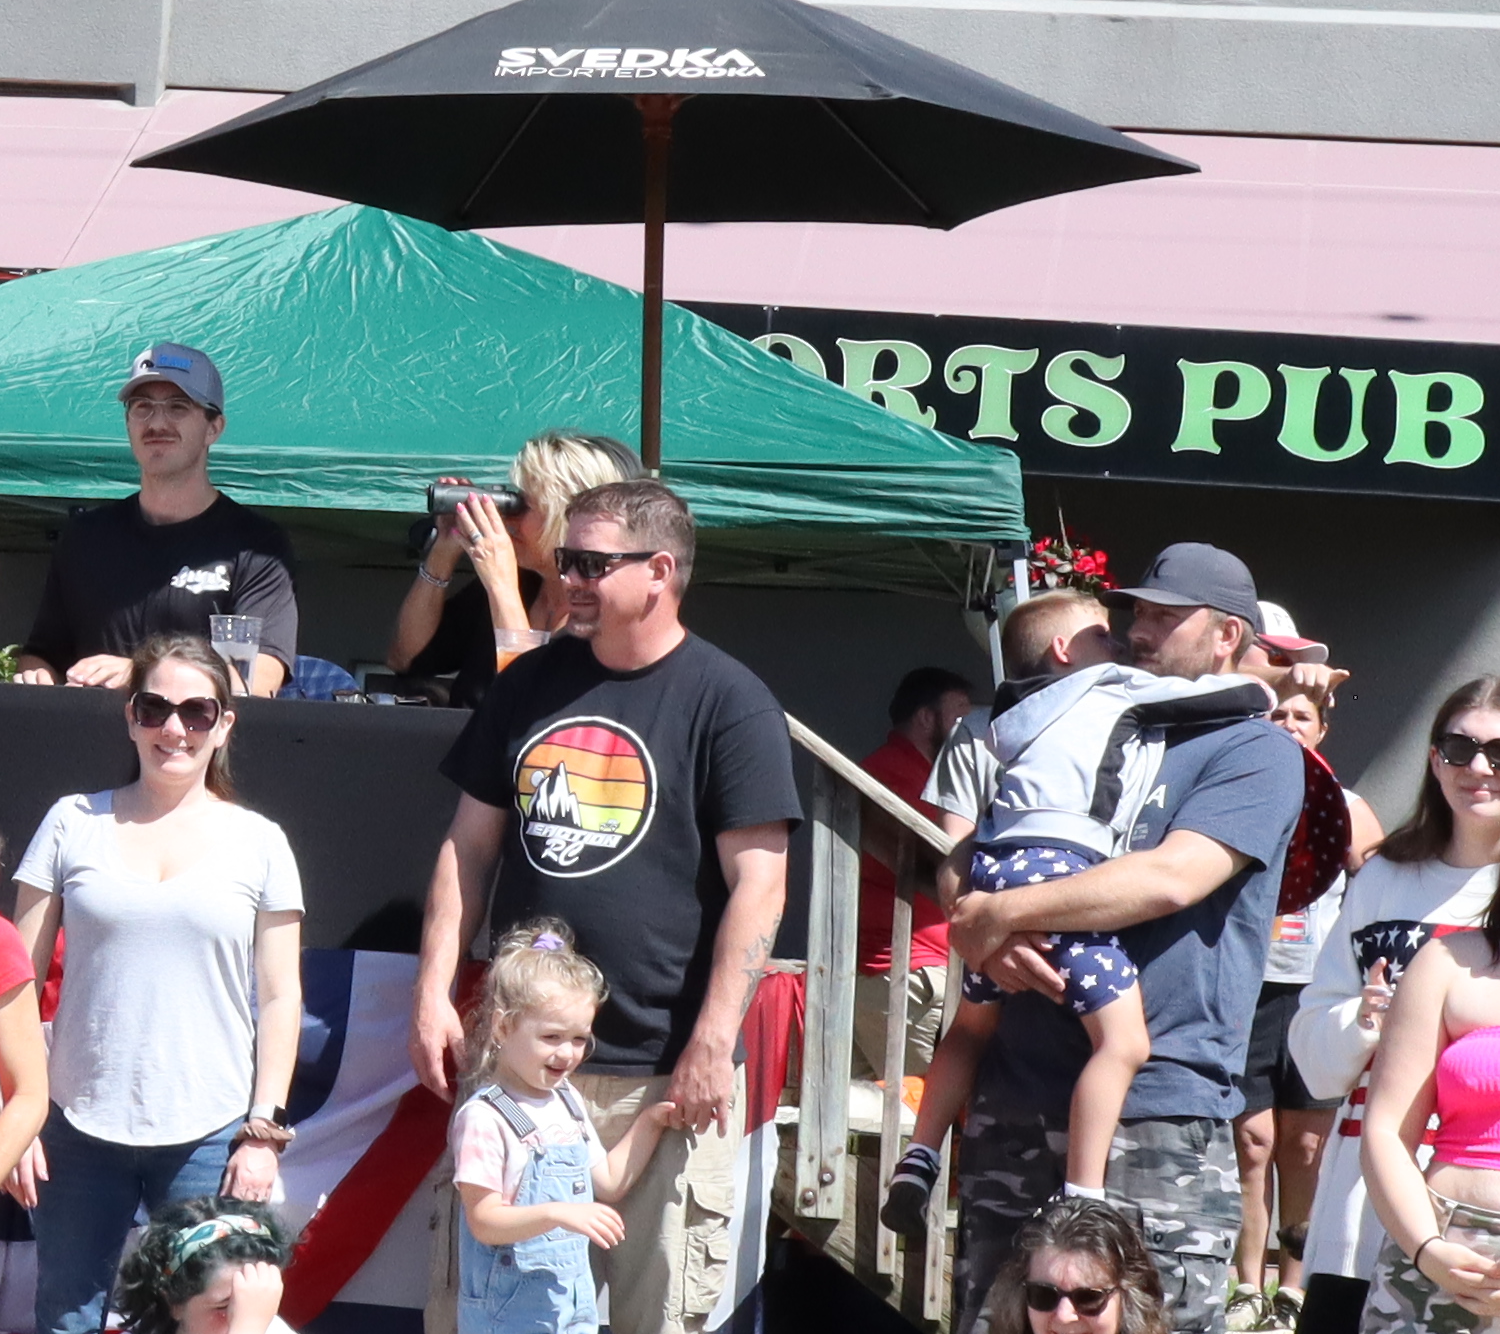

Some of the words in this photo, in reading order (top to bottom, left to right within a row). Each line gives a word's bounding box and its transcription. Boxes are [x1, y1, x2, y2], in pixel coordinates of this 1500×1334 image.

[498, 47, 756, 68] SVEDKA
[494, 67, 658, 79] IMPORTED
[659, 67, 767, 78] VODKA
[1171, 358, 1486, 469] PUB
[540, 837, 585, 866] RC
